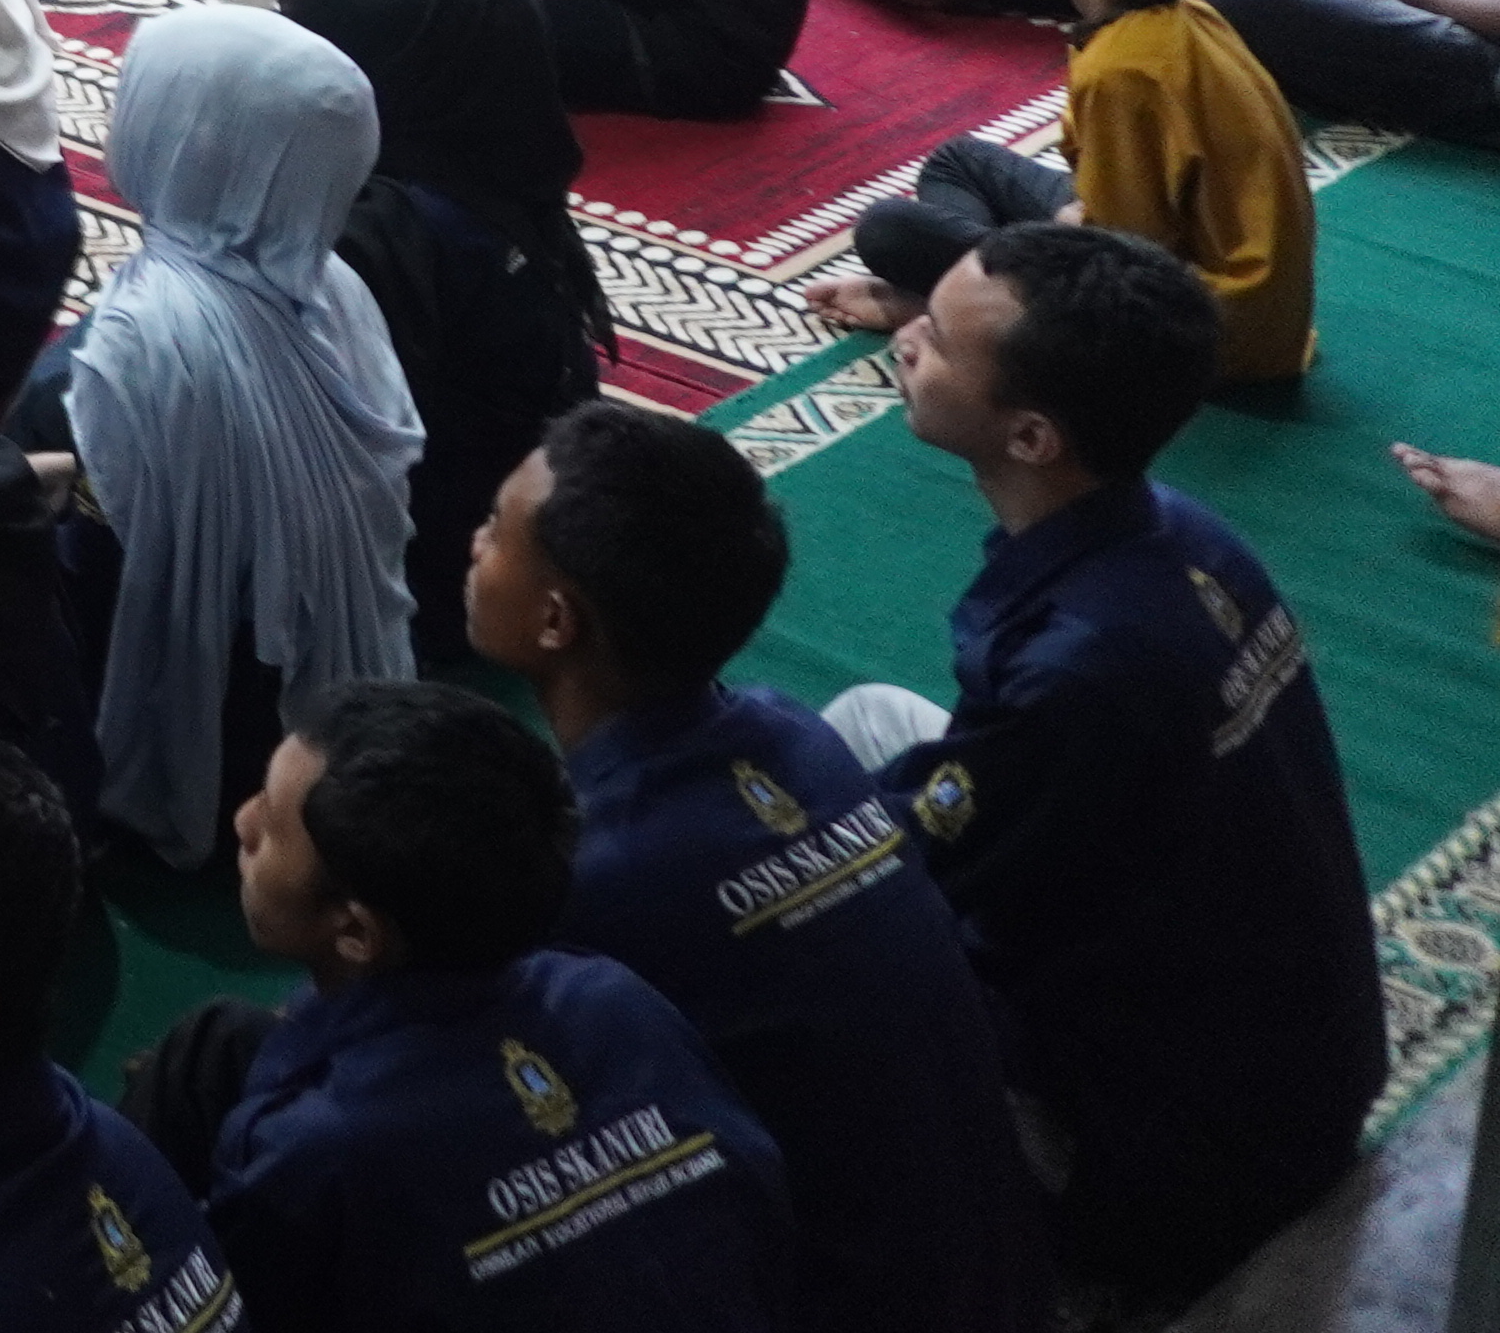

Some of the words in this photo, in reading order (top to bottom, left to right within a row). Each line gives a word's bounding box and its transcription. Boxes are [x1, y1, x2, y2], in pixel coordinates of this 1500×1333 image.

[715, 855, 802, 919] OSIS
[486, 1157, 563, 1224] OSIS
[553, 1103, 678, 1194] SKANURI
